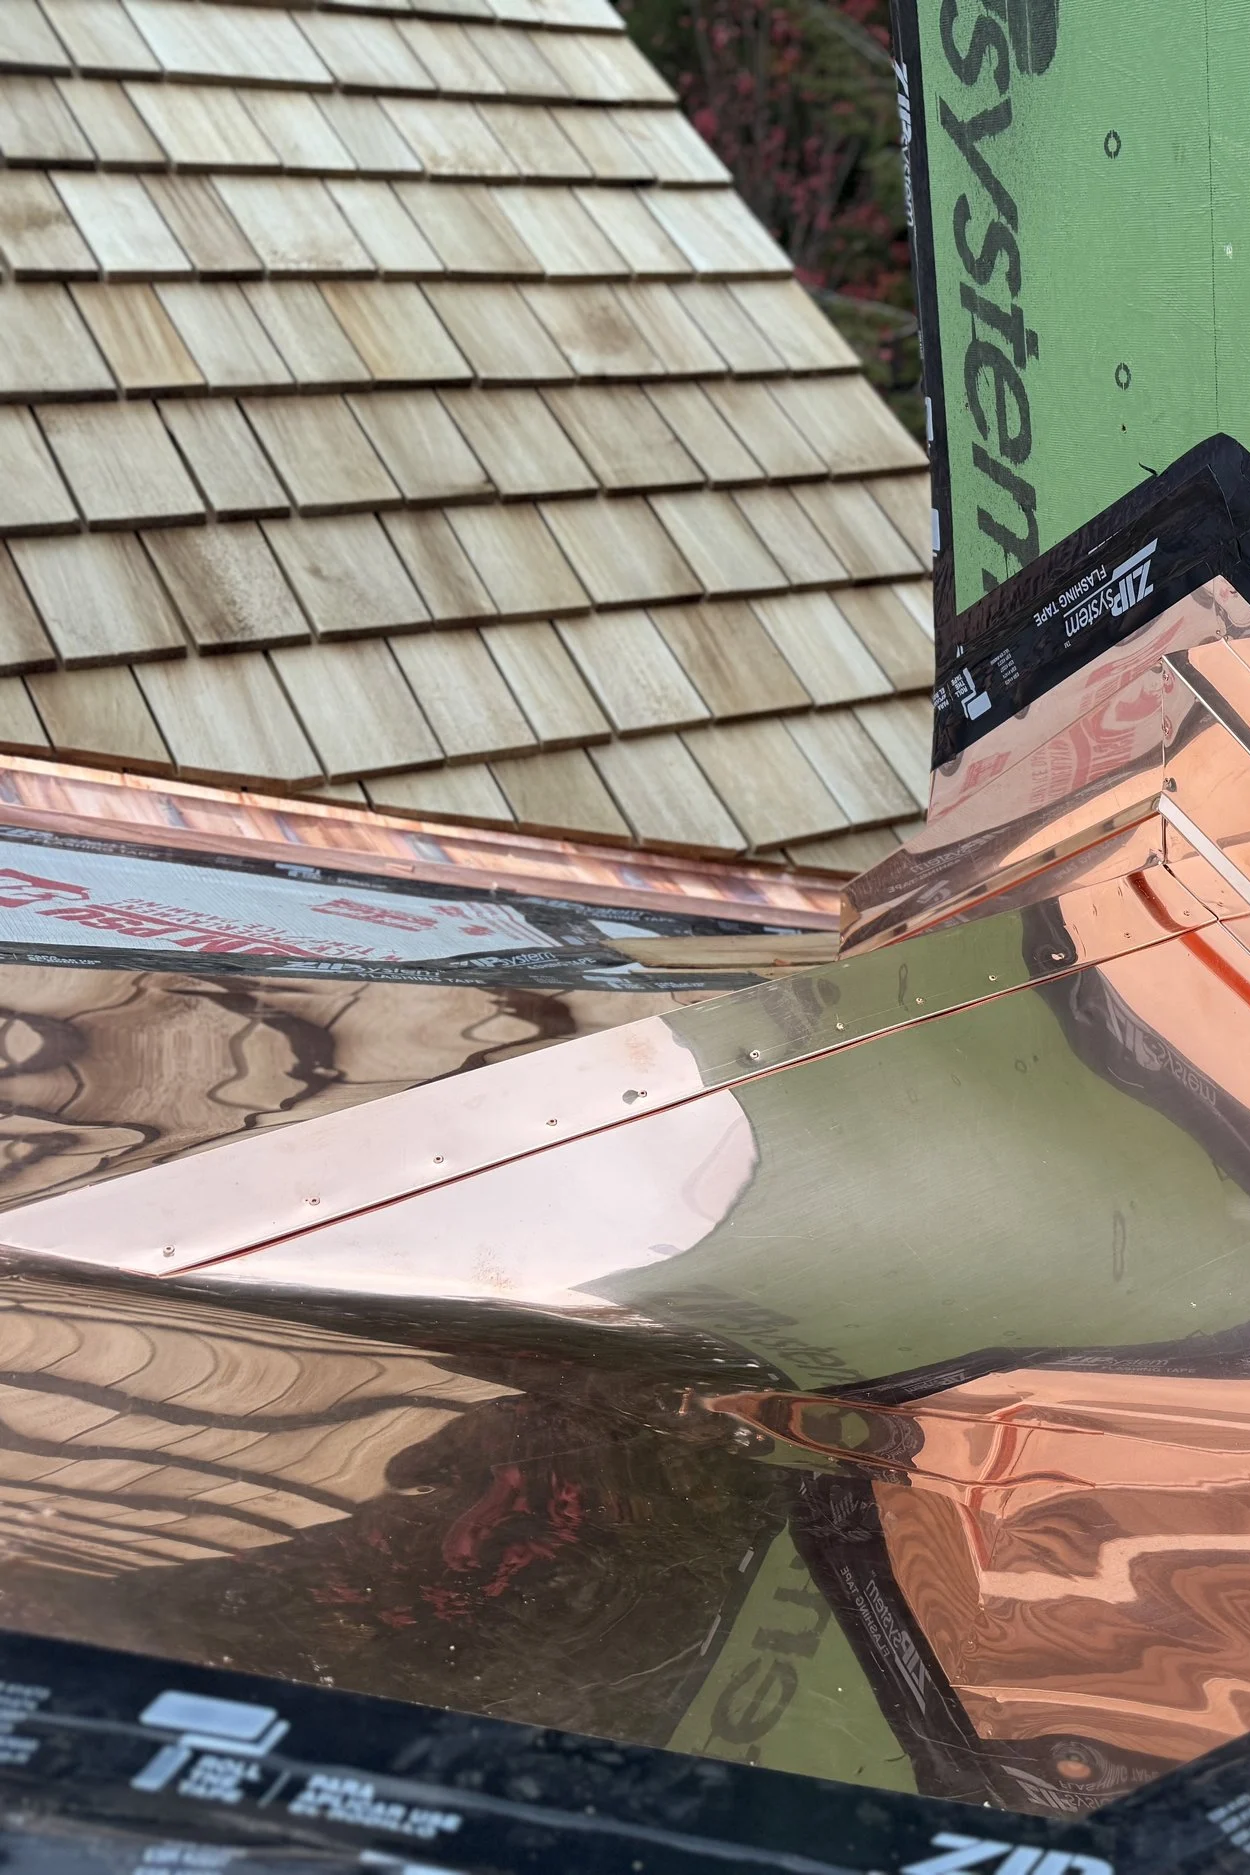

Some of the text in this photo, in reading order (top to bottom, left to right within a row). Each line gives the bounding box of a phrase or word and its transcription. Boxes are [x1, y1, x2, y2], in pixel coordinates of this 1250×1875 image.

[1034, 564, 1107, 627] FLASHING TAPE
[306, 1773, 376, 1800] PARA
[407, 1808, 464, 1834] USE
